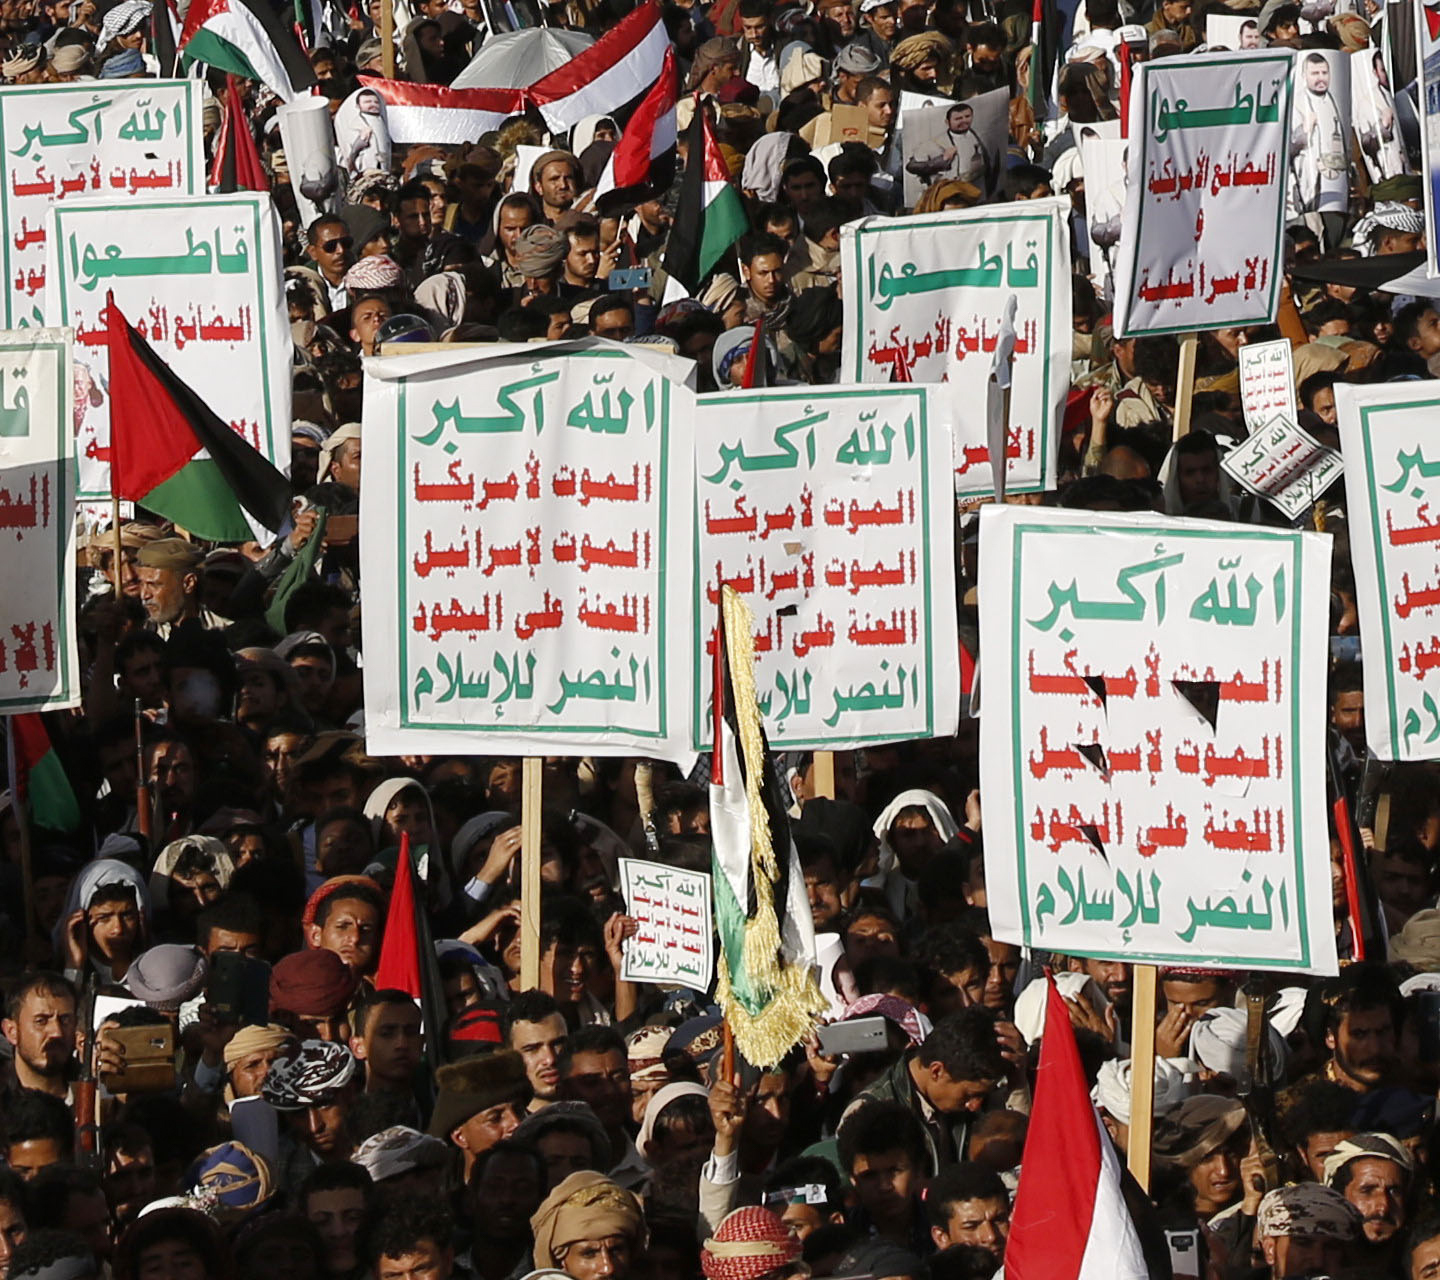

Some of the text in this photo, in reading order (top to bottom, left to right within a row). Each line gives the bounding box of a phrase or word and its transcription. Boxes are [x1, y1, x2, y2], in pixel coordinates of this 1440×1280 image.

[1151, 78, 1280, 143] قاطعوا
[1210, 150, 1275, 197] البضائع
[1193, 208, 1204, 242] و
[413, 366, 657, 457] الله أكبر
[412, 451, 654, 513] الموت لأمريكا
[549, 529, 654, 575] الموت
[410, 585, 653, 644] اللعنة على اليهود
[546, 646, 653, 717] النصر
